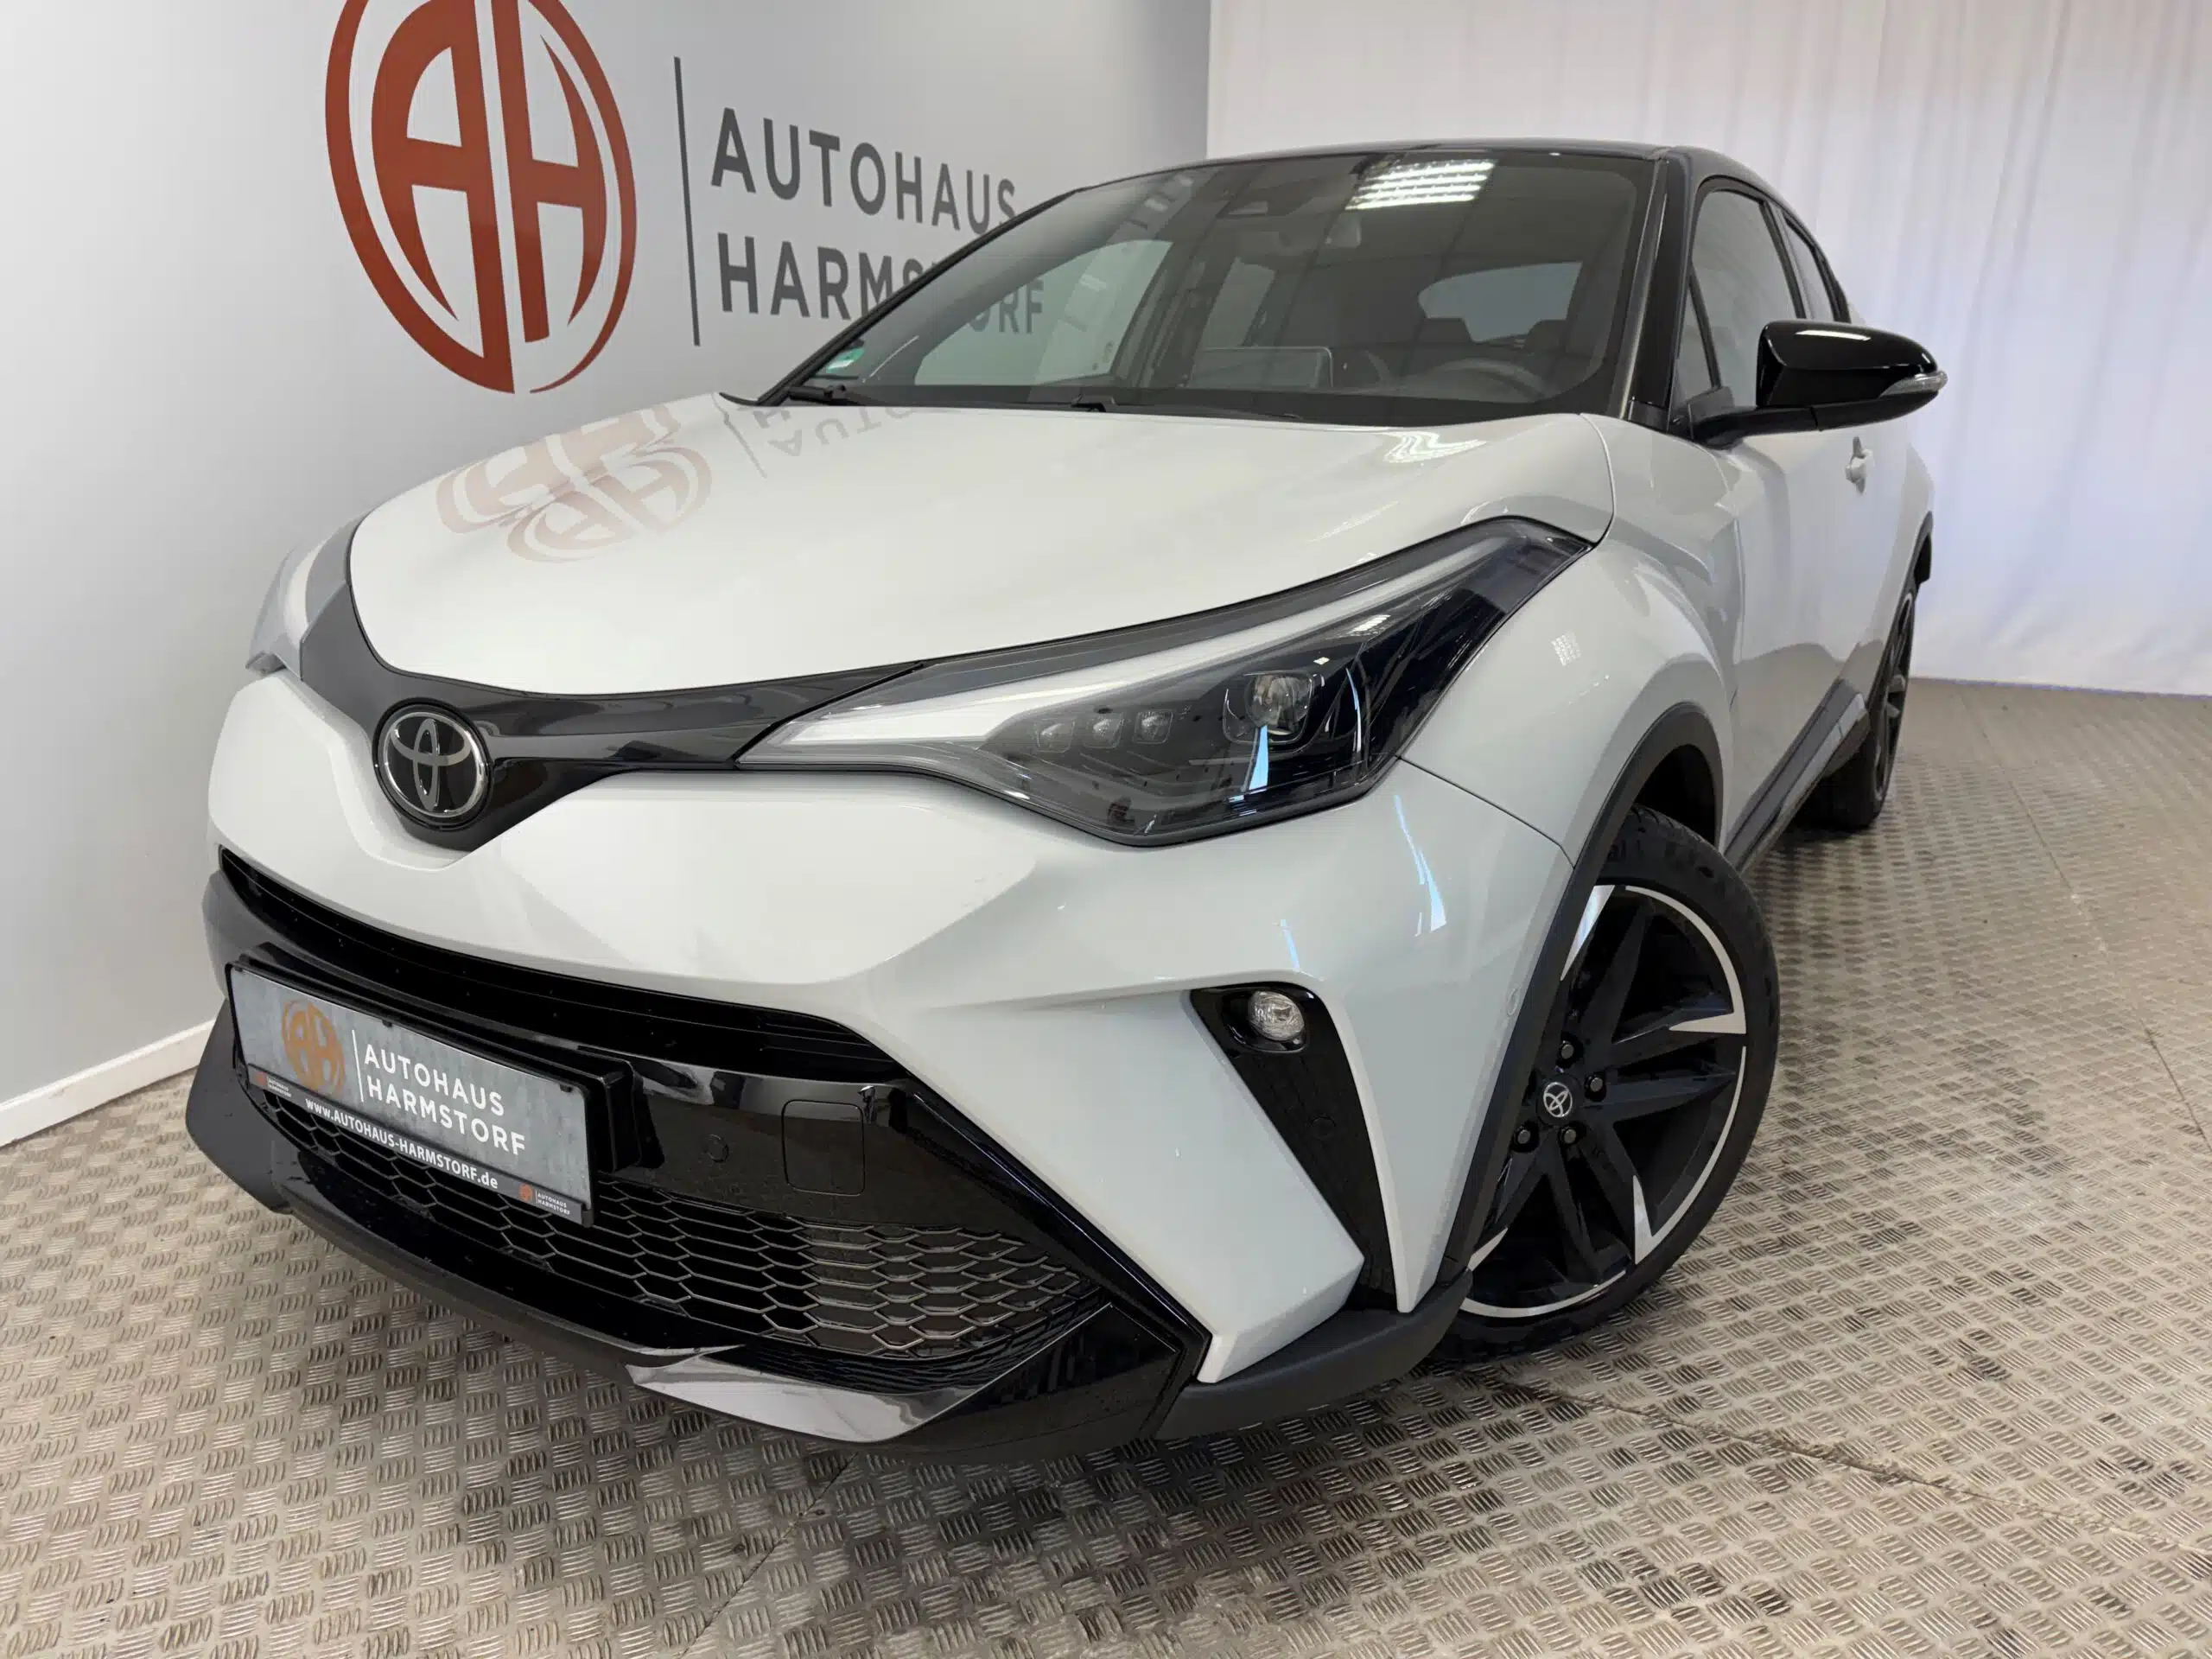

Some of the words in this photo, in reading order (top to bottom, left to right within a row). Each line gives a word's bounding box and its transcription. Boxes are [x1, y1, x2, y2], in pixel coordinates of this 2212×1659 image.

[710, 107, 1016, 235] AUTOHAUS
[365, 1044, 504, 1116] AUTOHAUS
[367, 1075, 525, 1155] HARMSTORF
[305, 1098, 499, 1189] www.AUTOHAUS-HARMSTORF.de
[537, 1192, 567, 1208] AUTOHAUS
